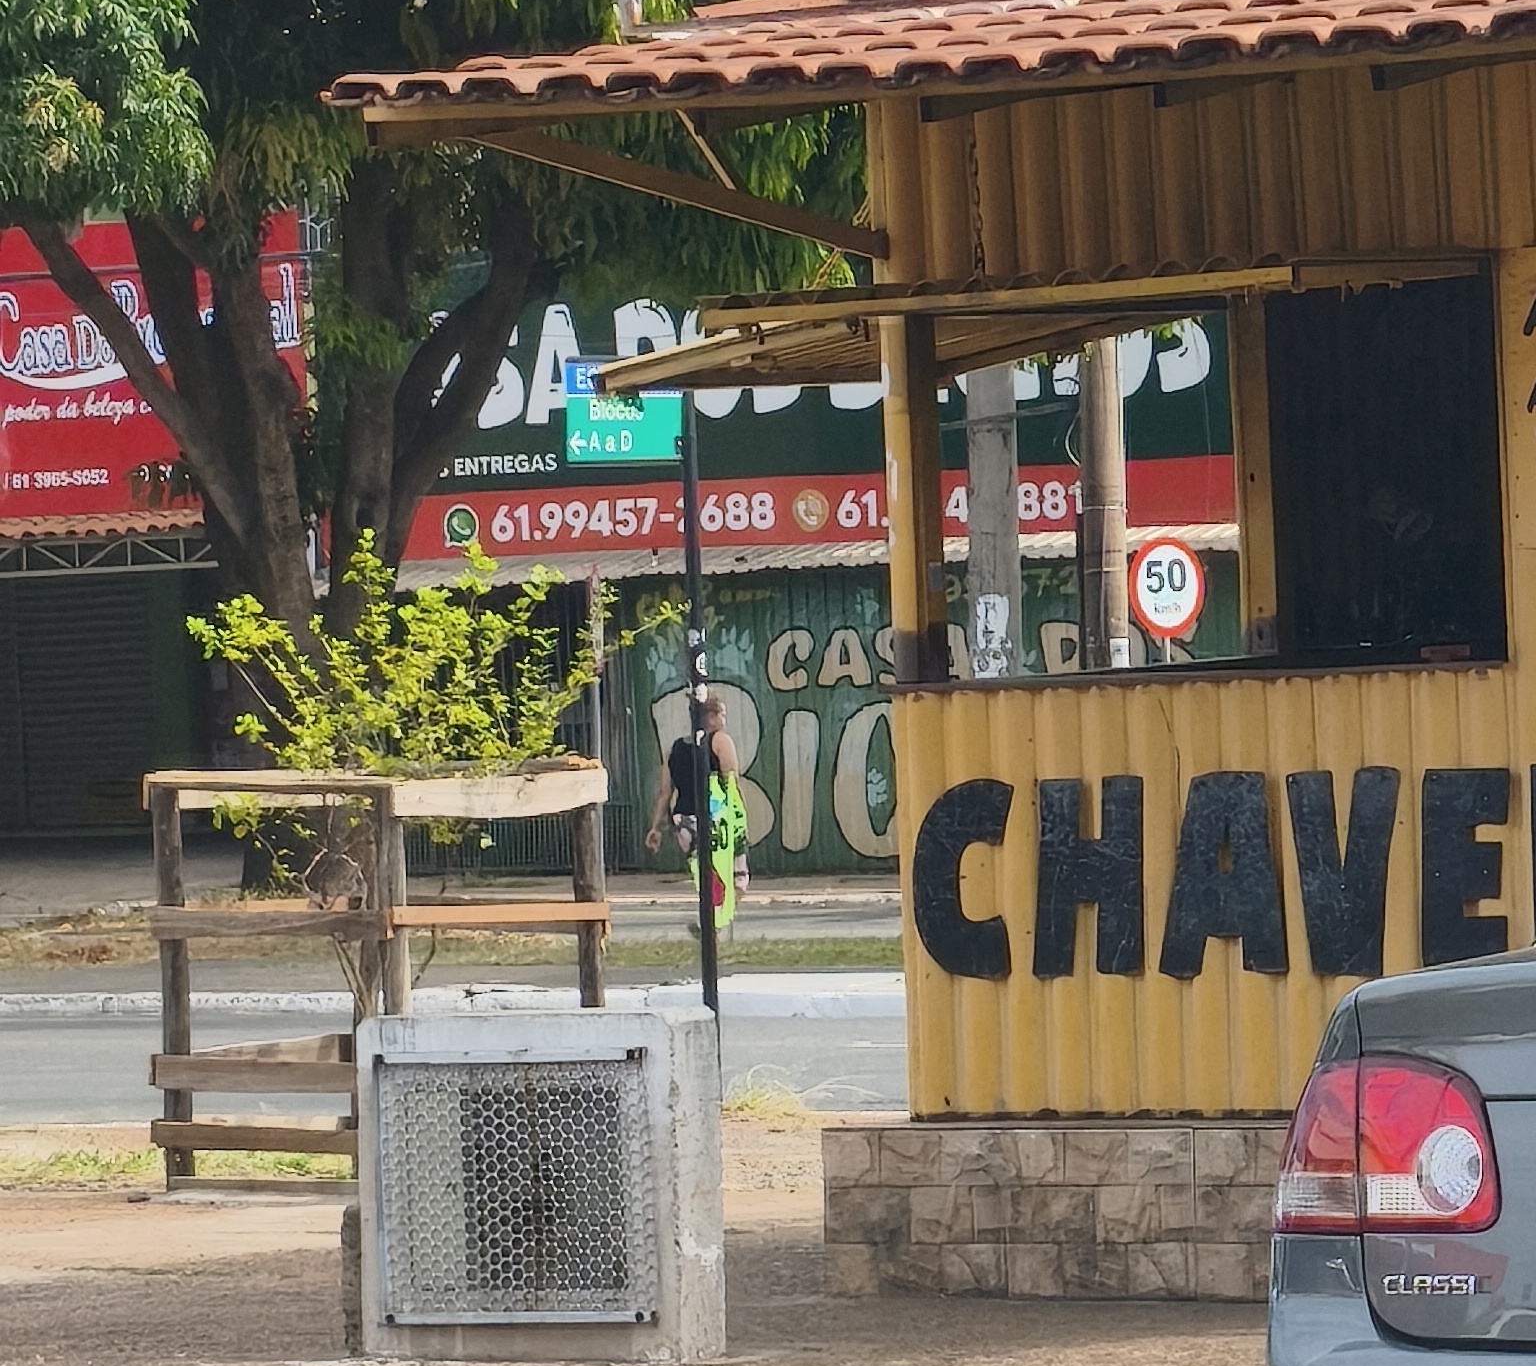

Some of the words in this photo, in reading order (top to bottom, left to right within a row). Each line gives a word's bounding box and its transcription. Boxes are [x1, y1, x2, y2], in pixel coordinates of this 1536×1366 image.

[56, 396, 78, 418] da
[589, 431, 601, 452] A
[604, 434, 617, 453] a
[620, 429, 633, 452] D
[453, 453, 559, 478] ENTREGAS
[1146, 558, 1187, 594] 50
